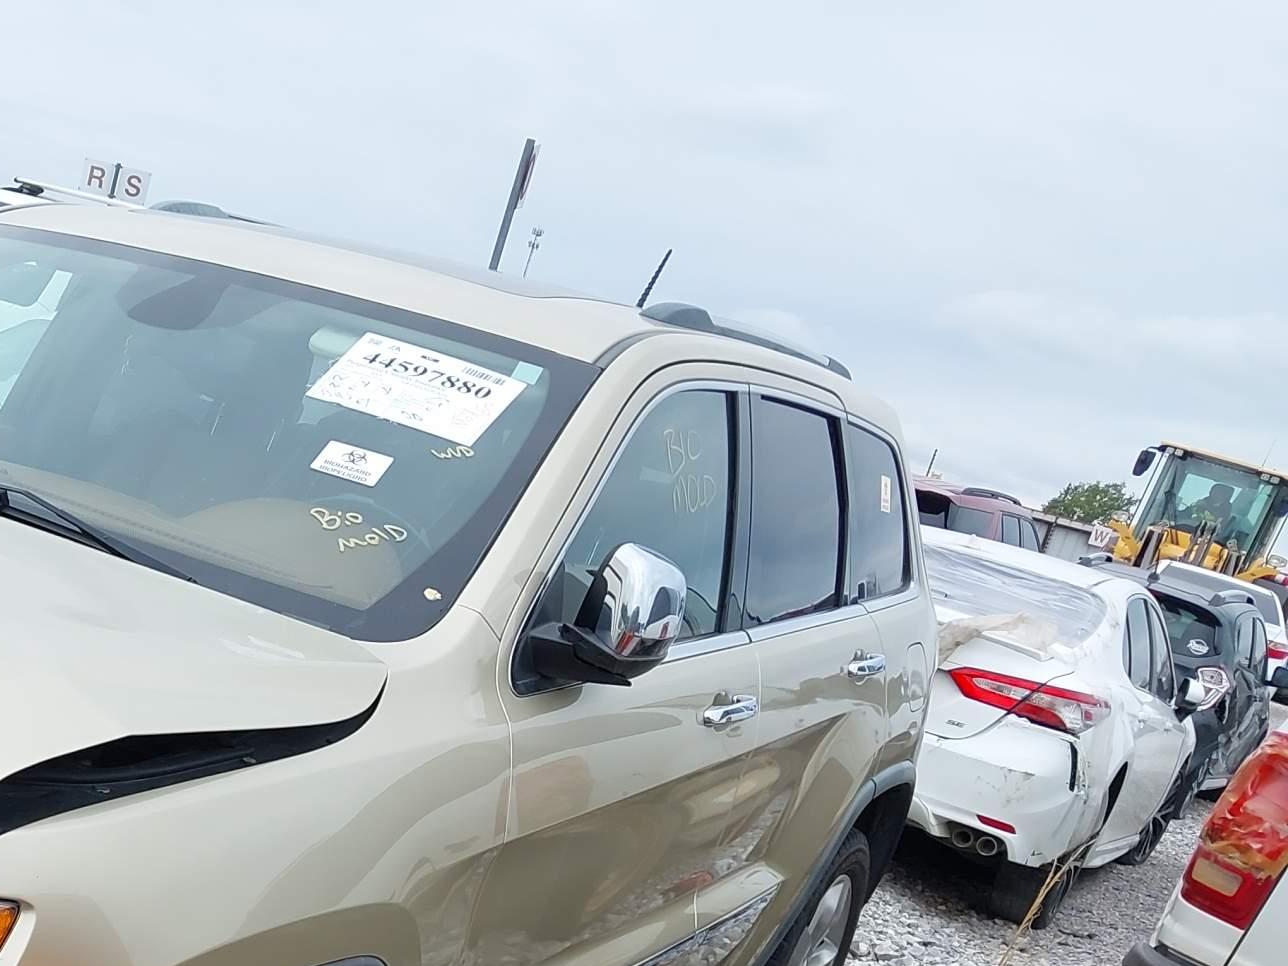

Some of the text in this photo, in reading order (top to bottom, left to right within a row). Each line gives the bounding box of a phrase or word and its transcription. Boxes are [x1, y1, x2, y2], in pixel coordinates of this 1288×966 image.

[87, 165, 106, 188] R
[124, 175, 142, 197] S
[361, 352, 492, 399] 44597880
[1094, 528, 1110, 543] W
